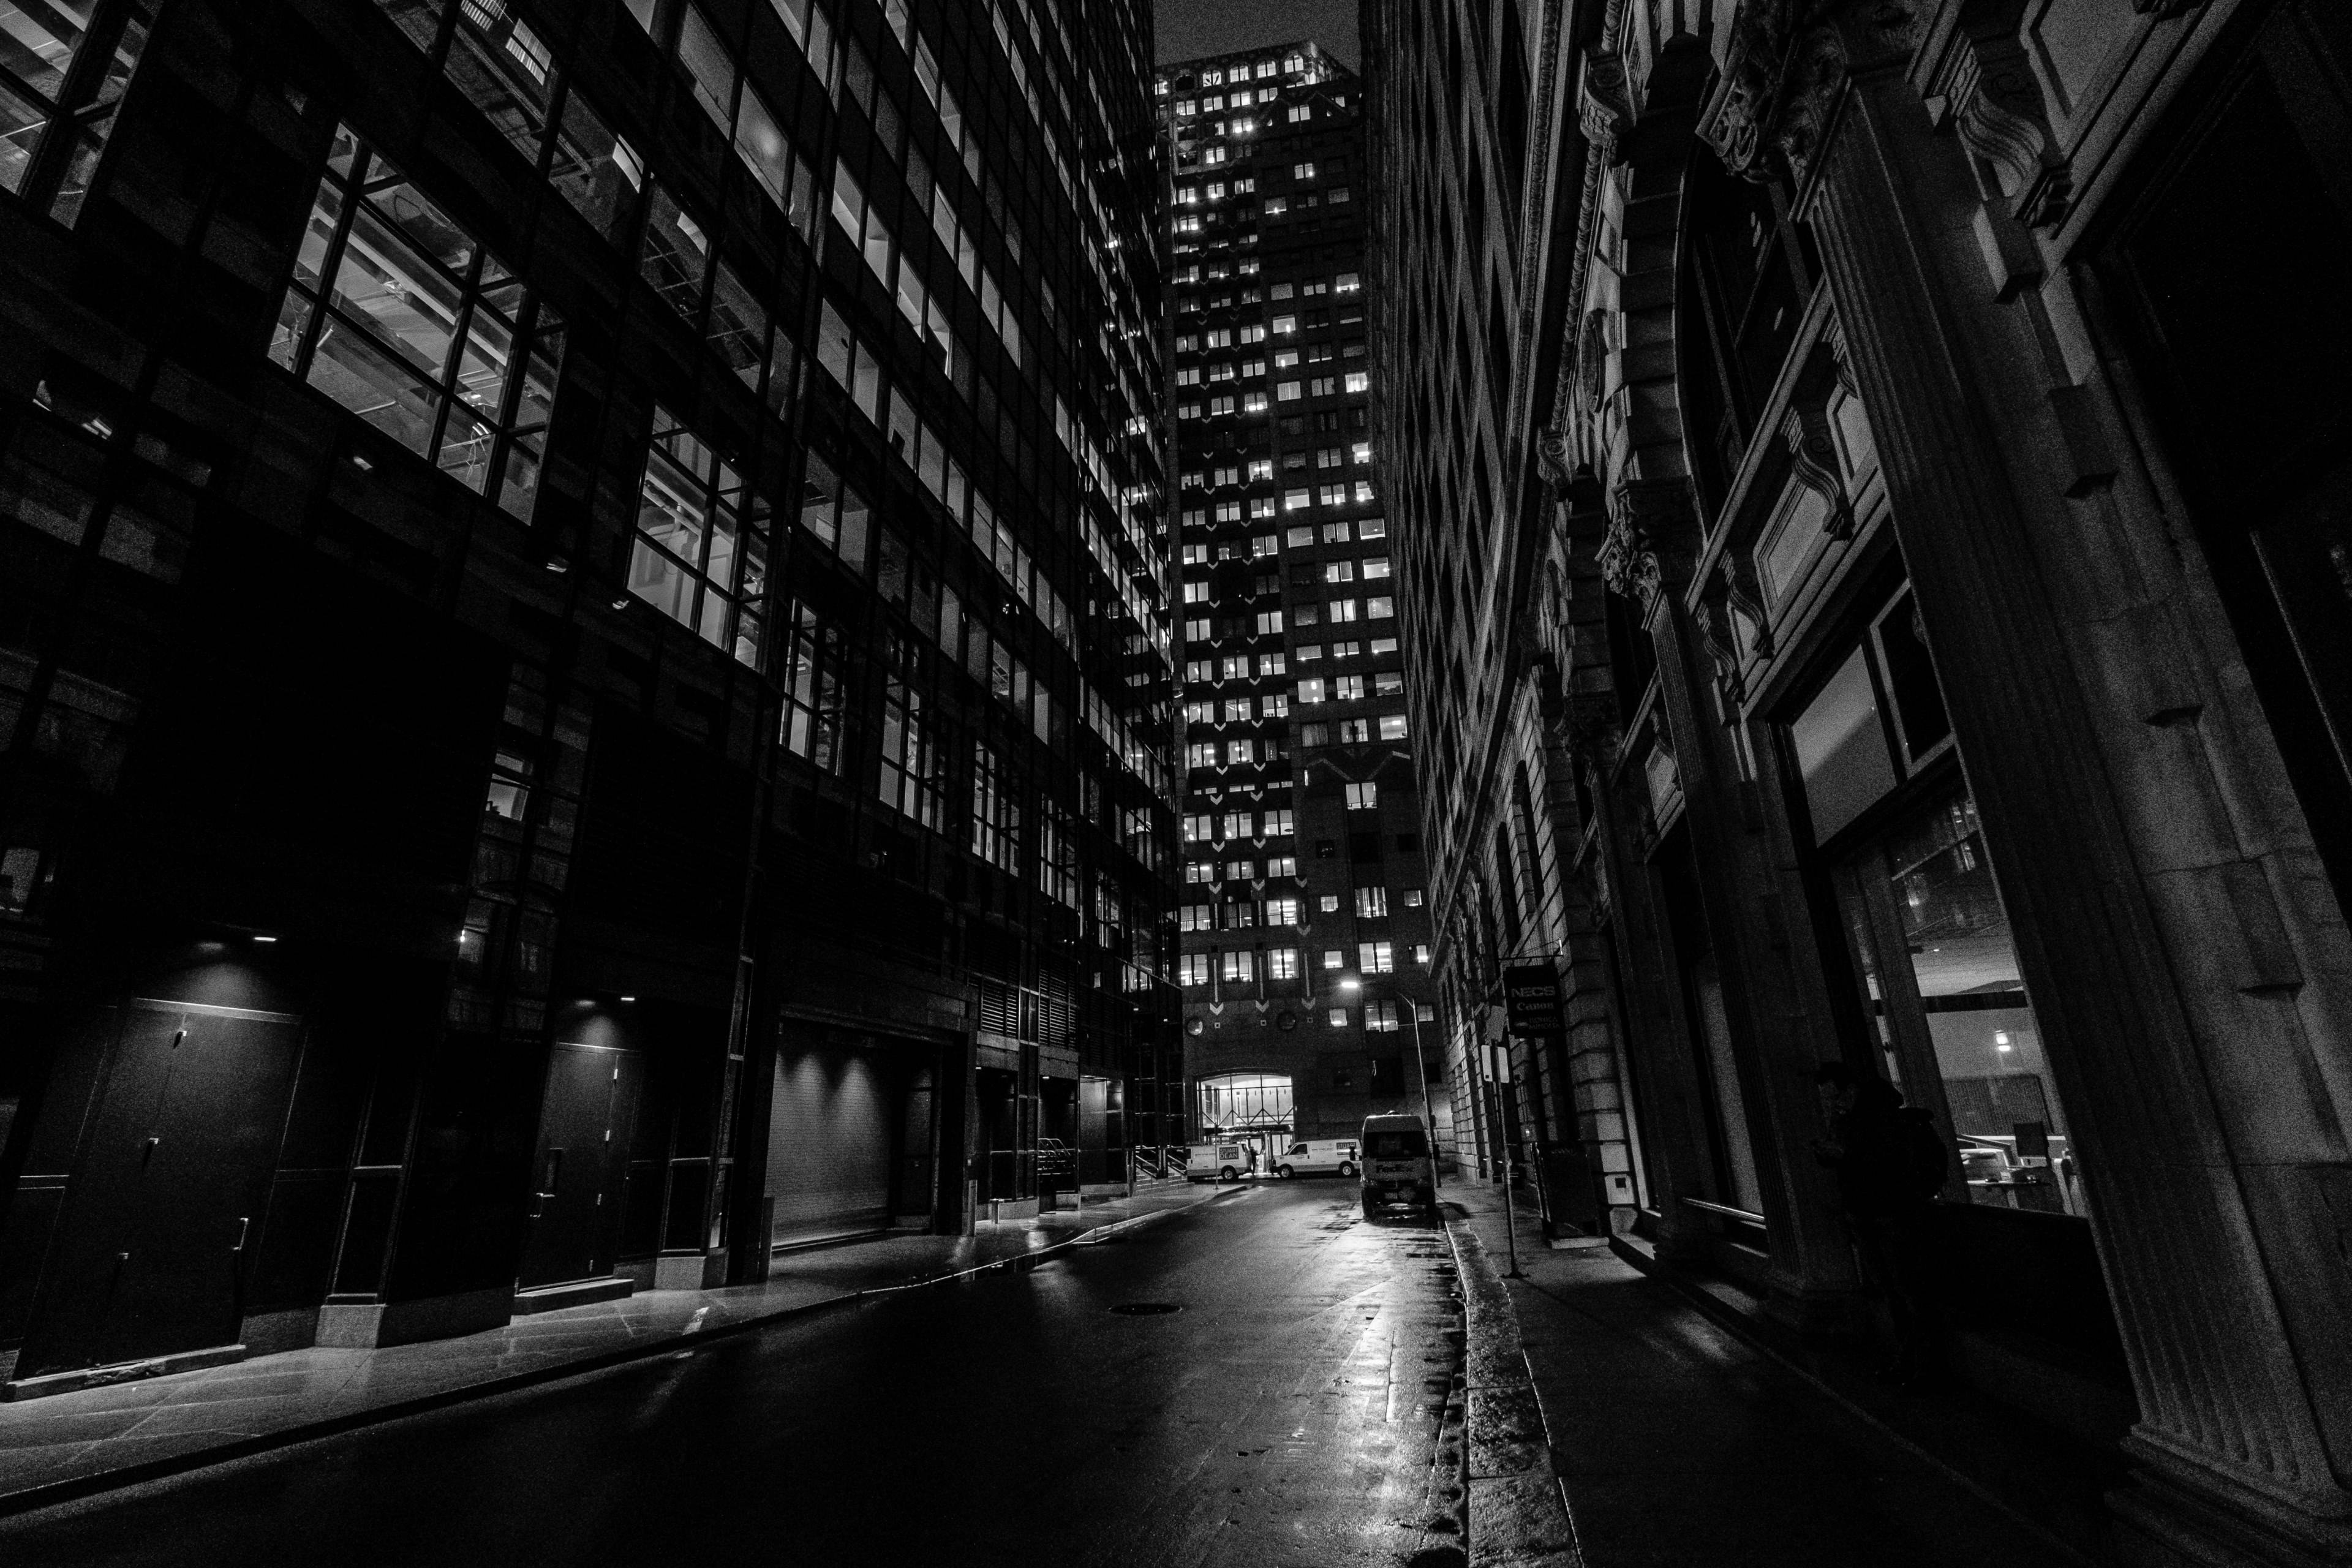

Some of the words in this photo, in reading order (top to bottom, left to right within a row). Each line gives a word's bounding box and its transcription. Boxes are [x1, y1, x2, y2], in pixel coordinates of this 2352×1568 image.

[1510, 986, 1556, 998] NECS
[1516, 1001, 1555, 1011] Canon
[1529, 1015, 1558, 1023] KONICA
[1376, 1164, 1414, 1173] FedEx
